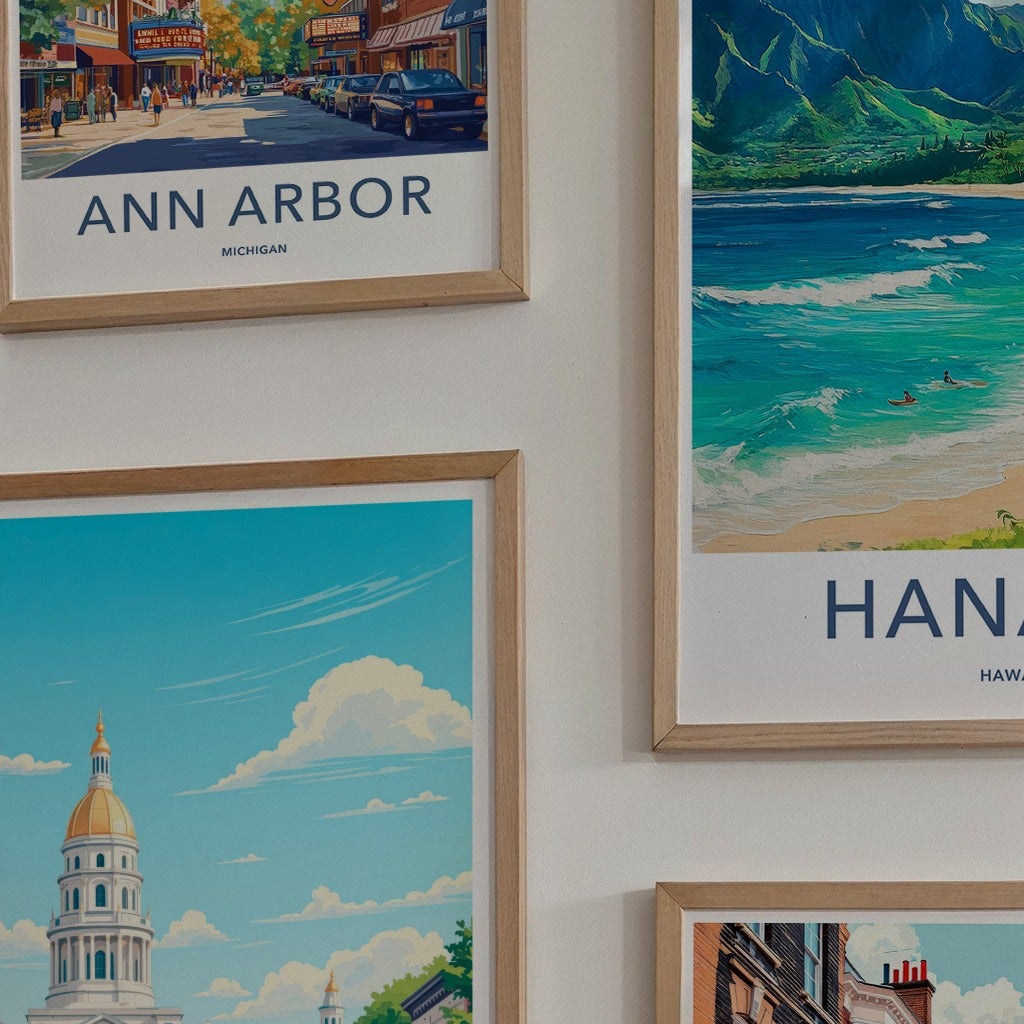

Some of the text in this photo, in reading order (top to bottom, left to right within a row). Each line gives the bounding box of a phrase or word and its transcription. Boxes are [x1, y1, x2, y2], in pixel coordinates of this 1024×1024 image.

[77, 175, 432, 236] ANN ARBOR
[221, 244, 287, 257] MICHIGAN
[827, 577, 1024, 639] HAN
[980, 668, 1024, 682] HAW
